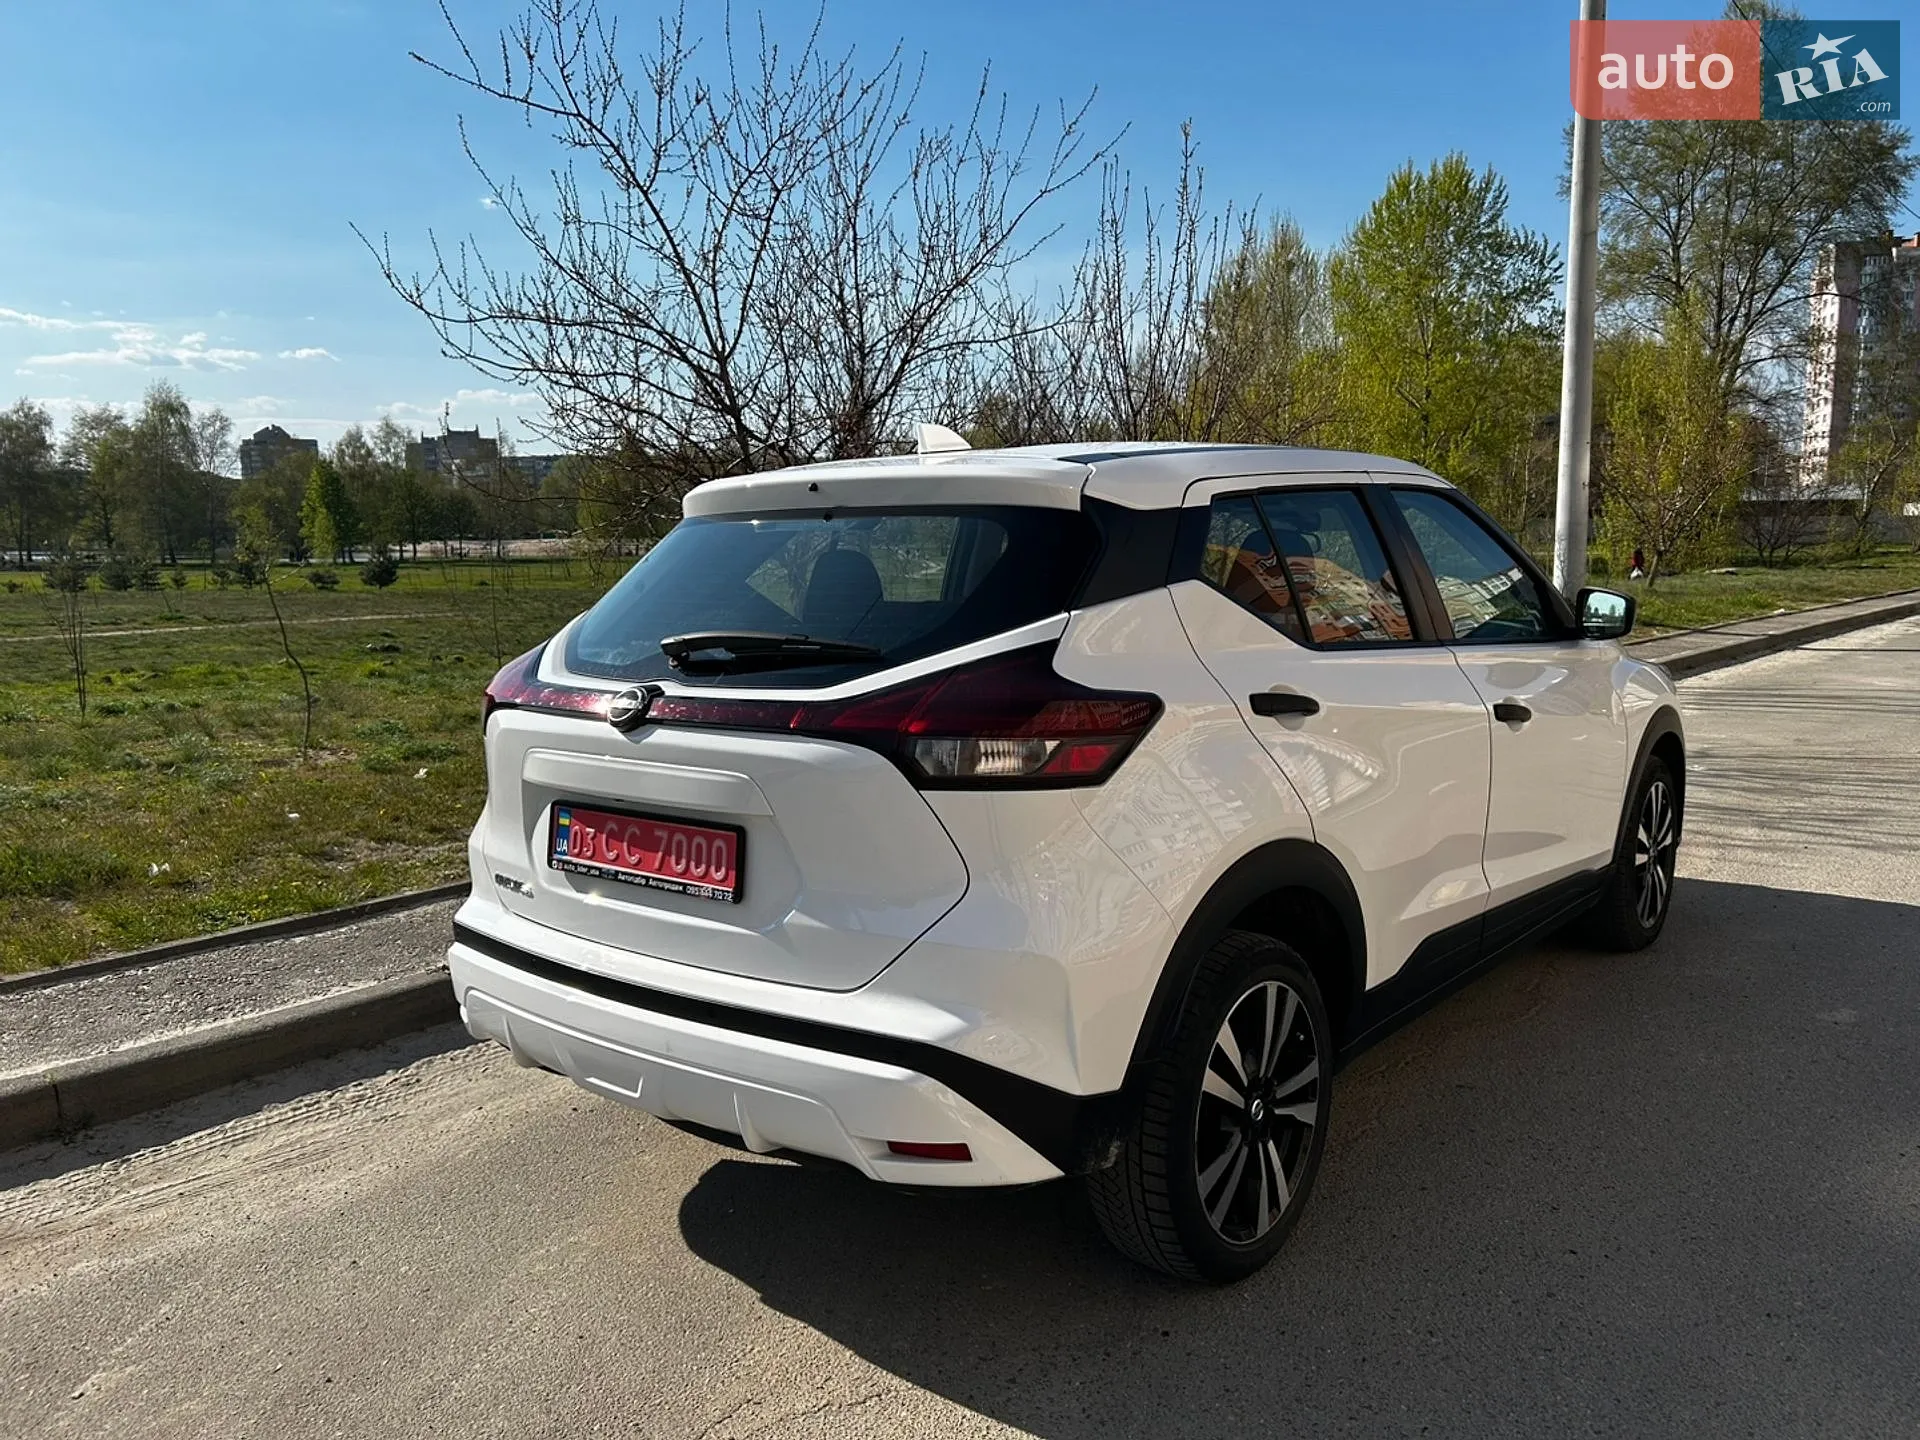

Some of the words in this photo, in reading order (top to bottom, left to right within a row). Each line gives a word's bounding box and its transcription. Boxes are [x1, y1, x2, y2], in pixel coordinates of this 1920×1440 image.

[556, 838, 568, 853] UA
[570, 825, 595, 857] 03
[602, 821, 640, 865] CC
[653, 828, 727, 880] 7000
